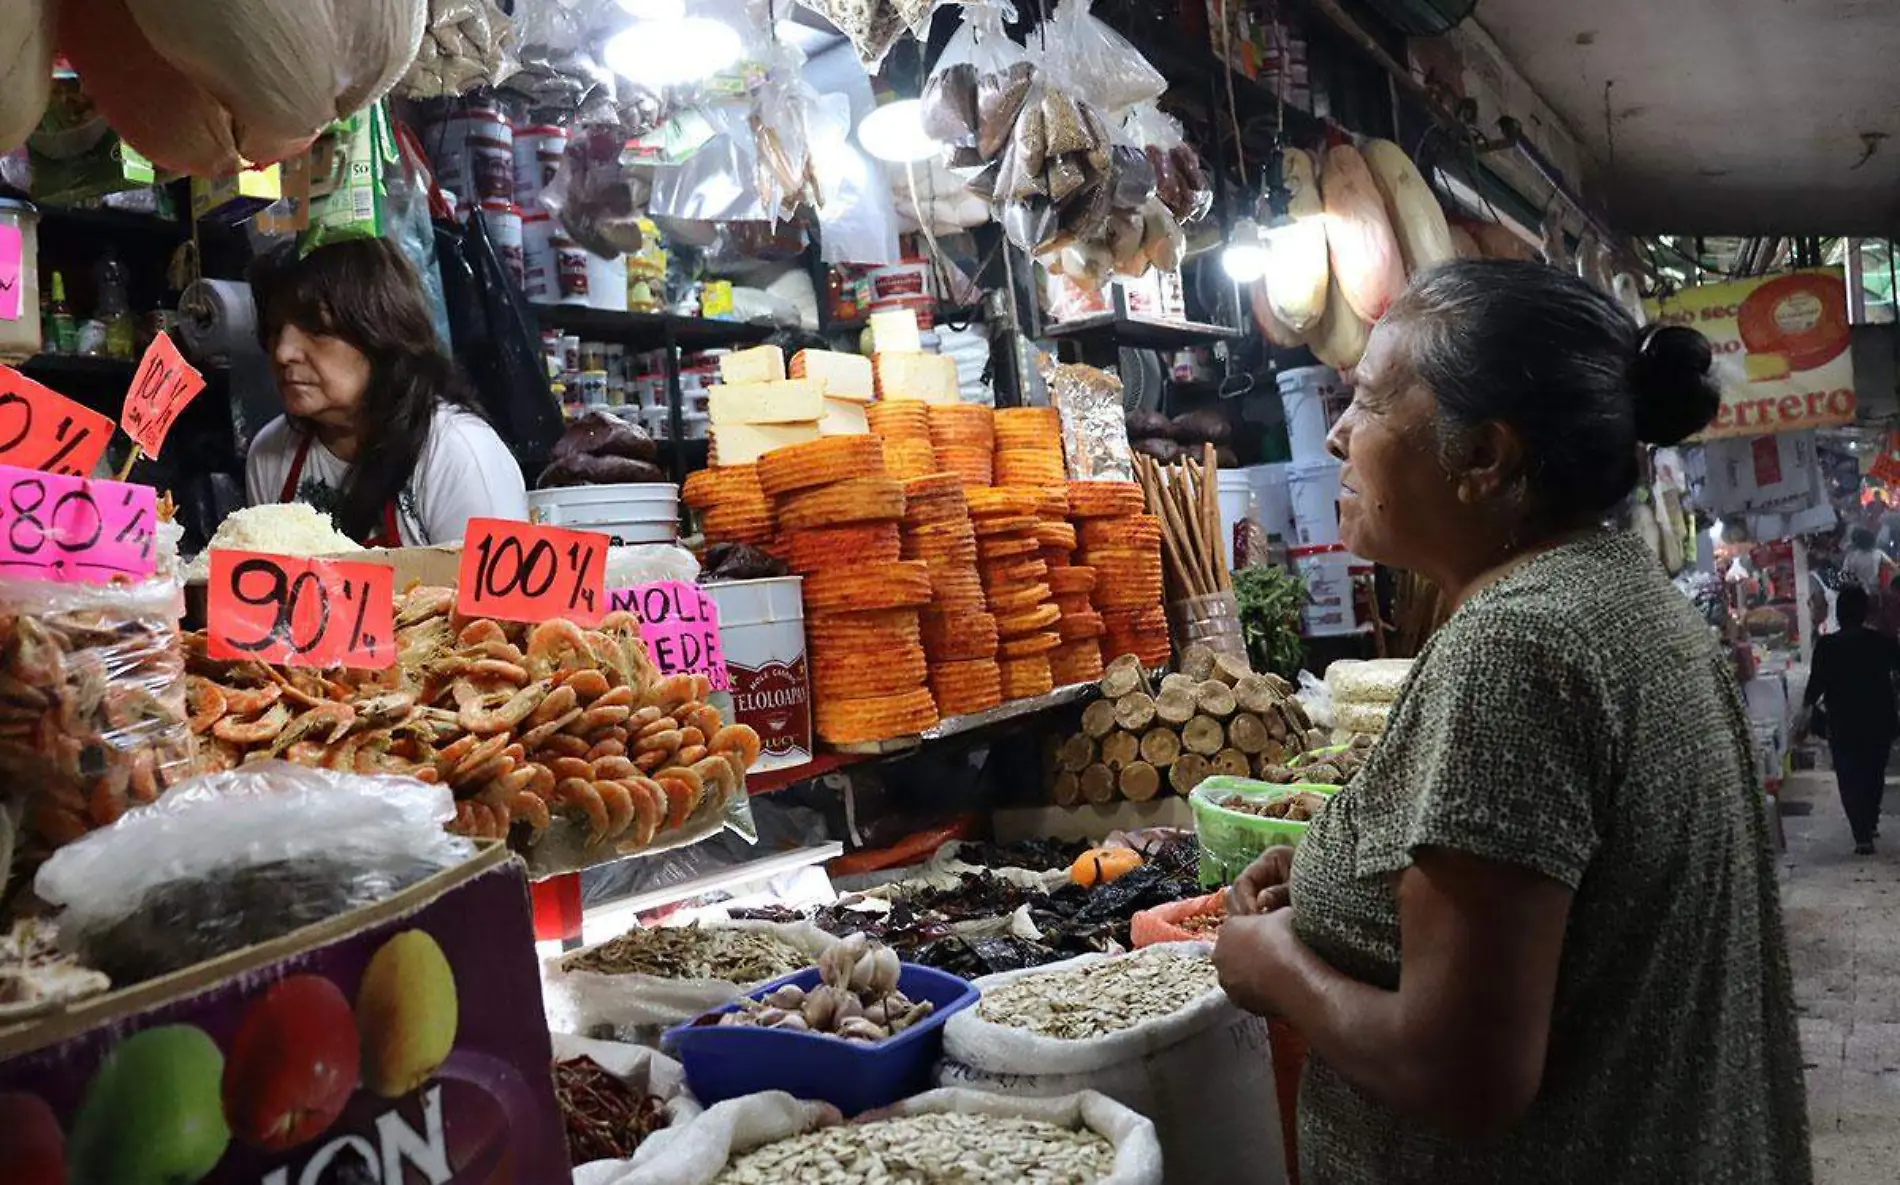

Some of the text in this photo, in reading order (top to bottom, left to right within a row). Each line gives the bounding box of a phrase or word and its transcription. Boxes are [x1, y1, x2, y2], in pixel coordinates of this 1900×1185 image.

[1711, 387, 1856, 430] errero
[473, 533, 596, 612] 100 1/4
[225, 558, 377, 658] 90 1/4
[611, 587, 710, 624] MOLE
[644, 631, 718, 672] EDE
[261, 1083, 453, 1185] ON
